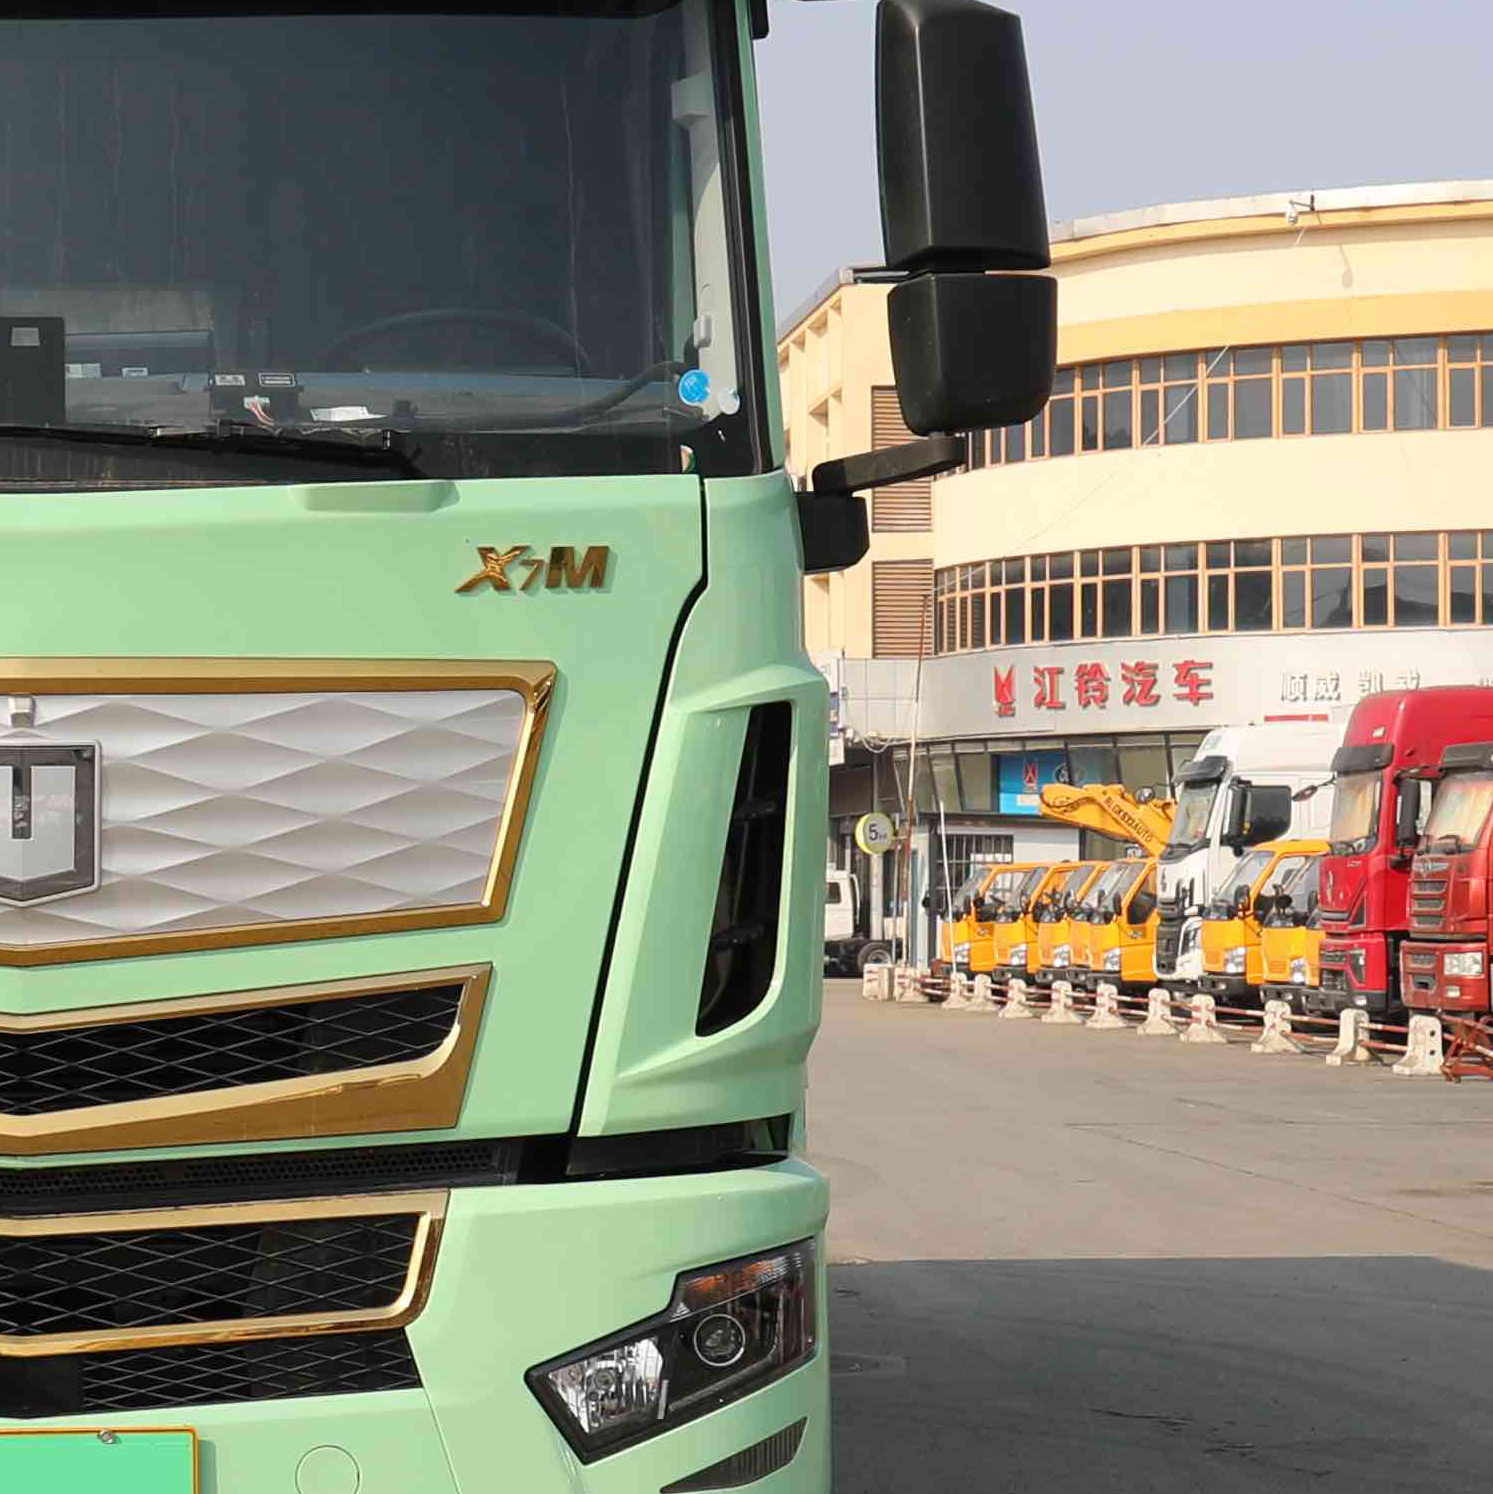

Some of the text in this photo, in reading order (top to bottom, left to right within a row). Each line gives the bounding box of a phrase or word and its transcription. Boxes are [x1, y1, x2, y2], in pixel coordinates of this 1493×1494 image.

[454, 545, 611, 593] X7M
[1033, 660, 1215, 709] 江铃汽车
